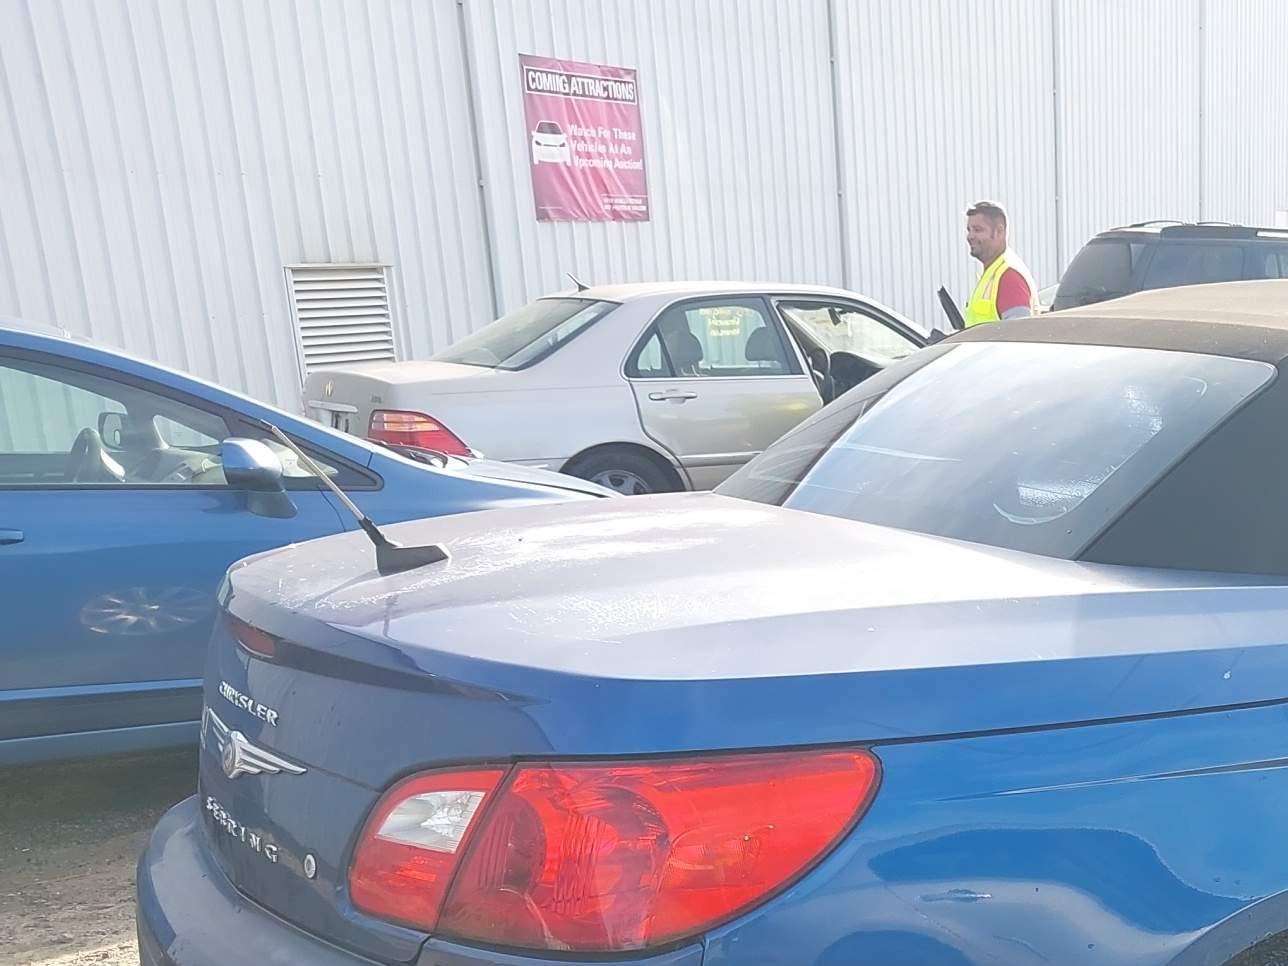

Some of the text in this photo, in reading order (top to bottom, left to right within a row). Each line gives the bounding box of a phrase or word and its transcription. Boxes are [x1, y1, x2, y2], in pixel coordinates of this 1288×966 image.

[570, 78, 635, 101] ATTRACTIONS
[567, 124, 637, 141] Watch For These
[570, 139, 632, 155] Vehicles At An
[206, 796, 277, 863] SEBRING
